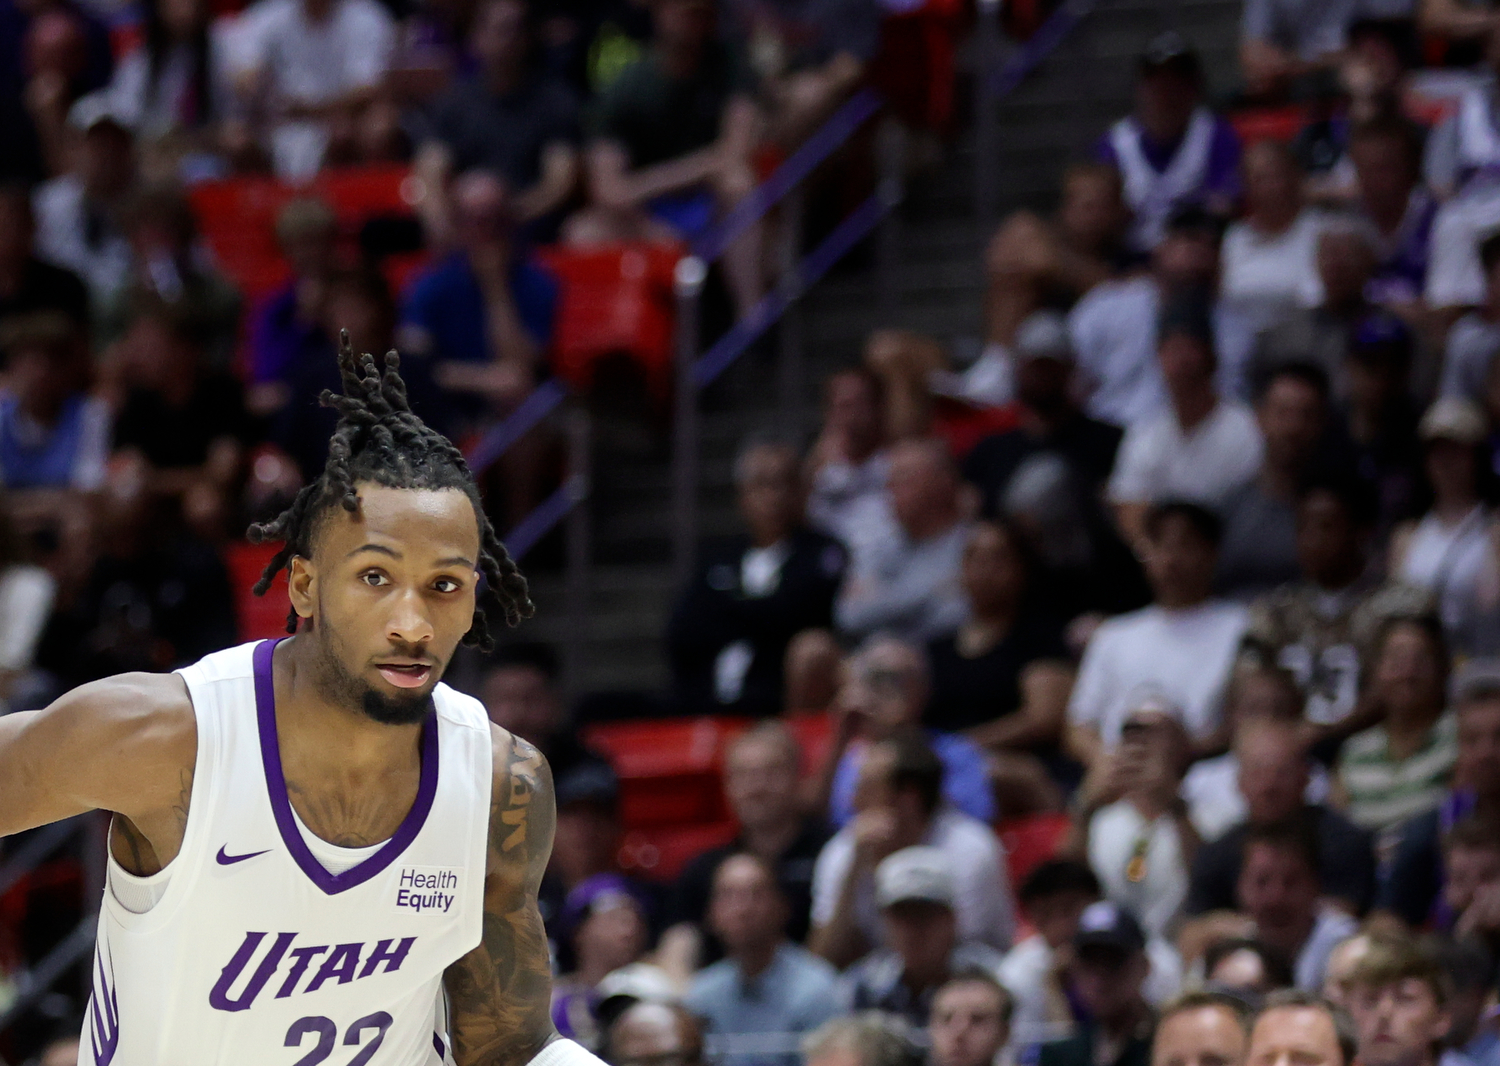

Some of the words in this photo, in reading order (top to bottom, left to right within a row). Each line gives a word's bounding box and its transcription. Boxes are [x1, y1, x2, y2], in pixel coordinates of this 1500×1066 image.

[400, 868, 458, 890] Health
[396, 889, 455, 913] Equity
[209, 931, 418, 1012] UTAH
